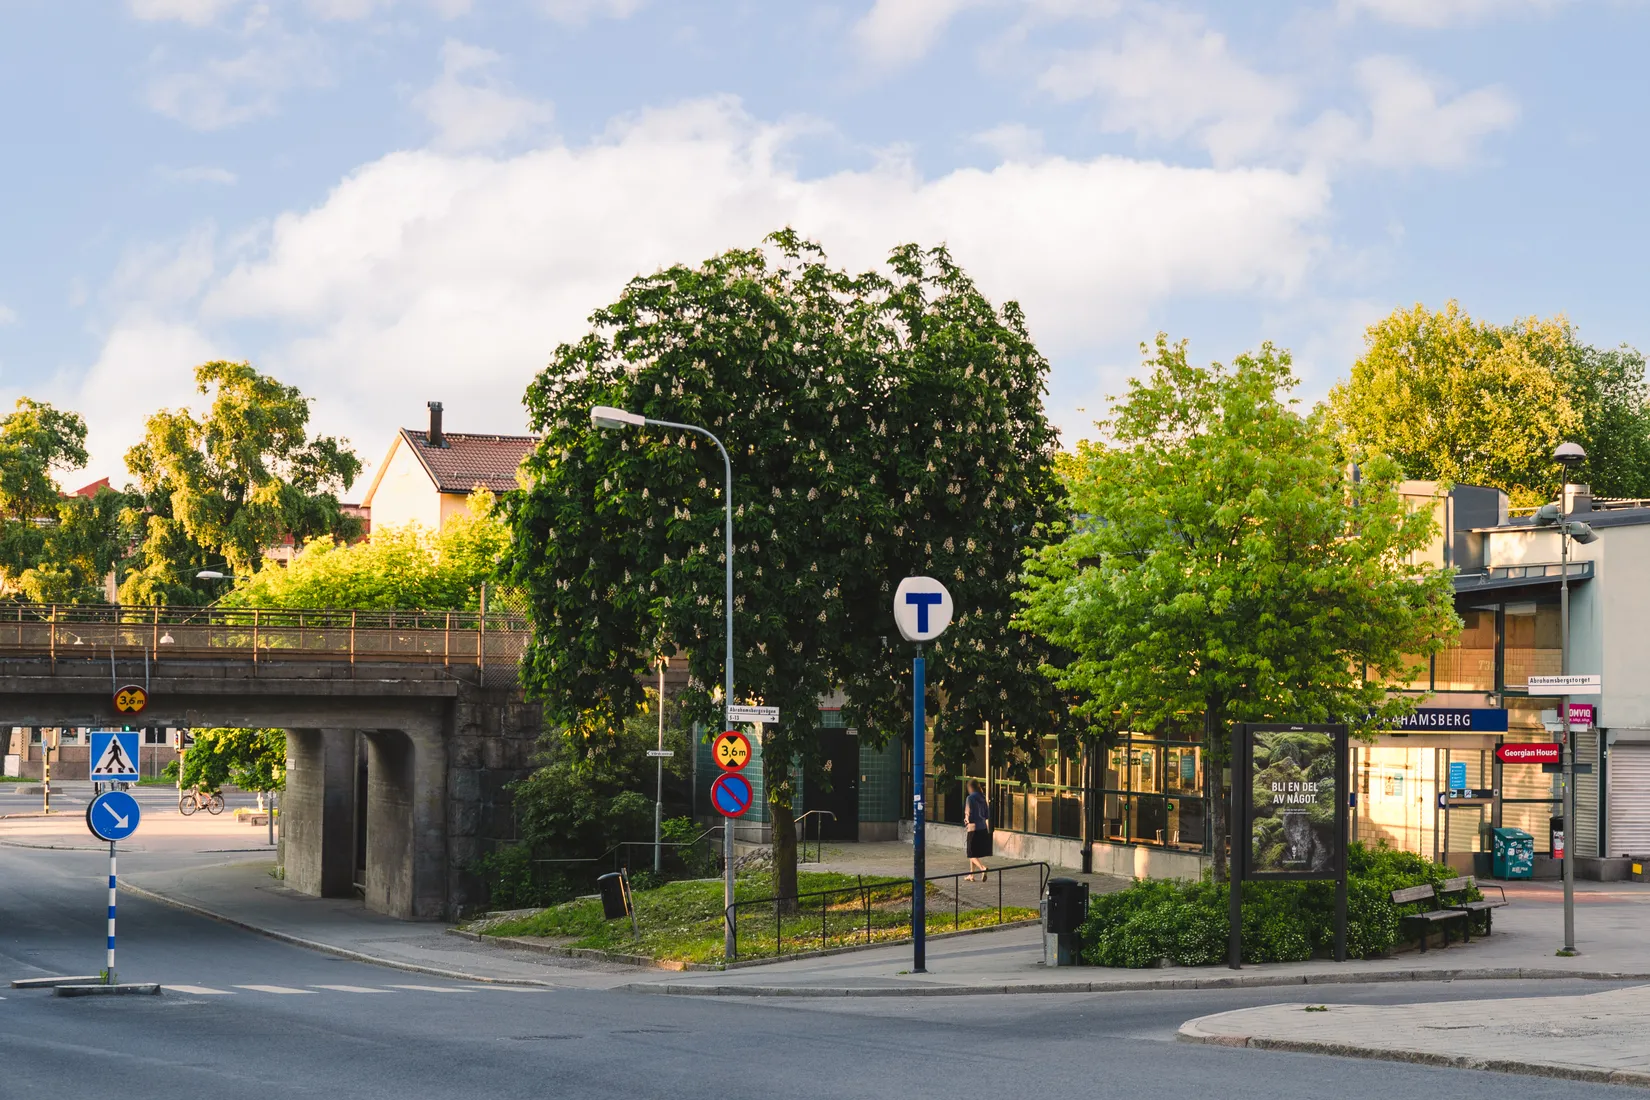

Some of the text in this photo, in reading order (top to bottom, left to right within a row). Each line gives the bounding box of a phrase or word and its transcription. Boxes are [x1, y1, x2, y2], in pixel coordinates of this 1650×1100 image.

[906, 592, 942, 633] T
[119, 695, 136, 706] 3,6
[1569, 708, 1591, 718] OMVIQ
[721, 745, 738, 758] 3,6
[1504, 749, 1535, 758] Georgian
[1271, 782, 1319, 792] BLI EN DEL
[1272, 792, 1318, 804] AV NÅGOT.
